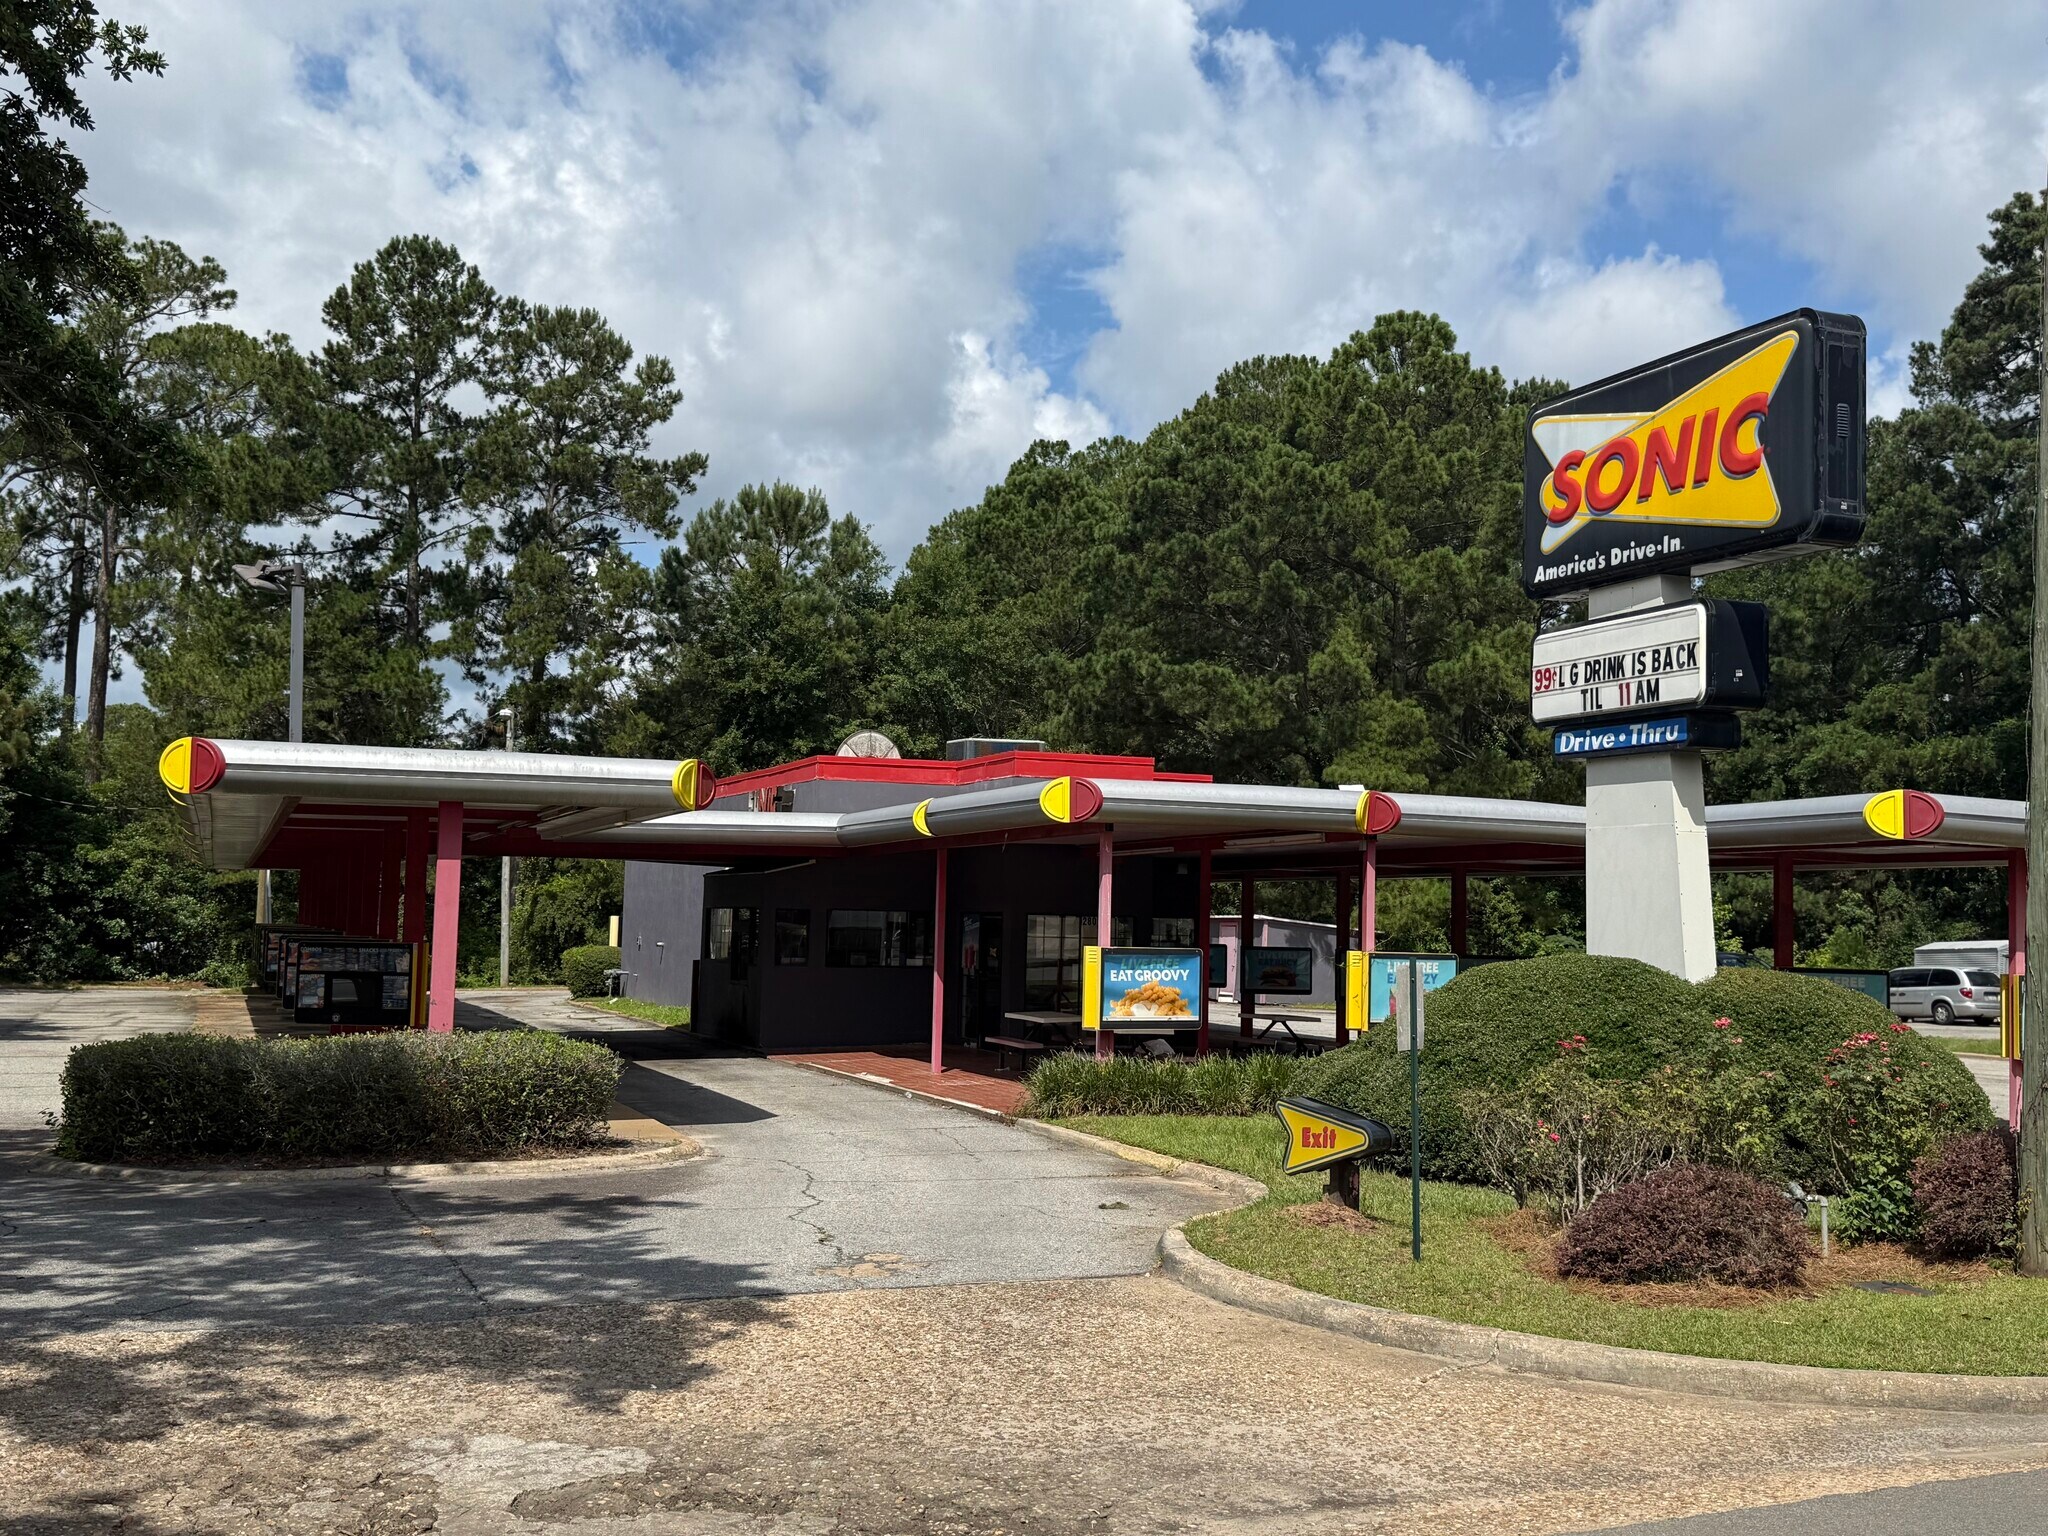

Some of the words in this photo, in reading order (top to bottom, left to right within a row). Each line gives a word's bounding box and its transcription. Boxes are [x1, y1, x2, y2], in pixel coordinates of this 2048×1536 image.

[1547, 391, 1769, 524] SONIC
[1533, 551, 1606, 584] America's
[1584, 654, 1626, 684] DRINK
[1631, 650, 1647, 676] IS
[1651, 641, 1698, 674] BACK
[1580, 686, 1603, 712] TIL
[1110, 969, 1133, 982] EAT
[1134, 969, 1190, 982] GROOVY
[1120, 958, 1148, 970] LIVE
[1150, 958, 1180, 970] FREE
[1301, 1126, 1337, 1149] Exit
